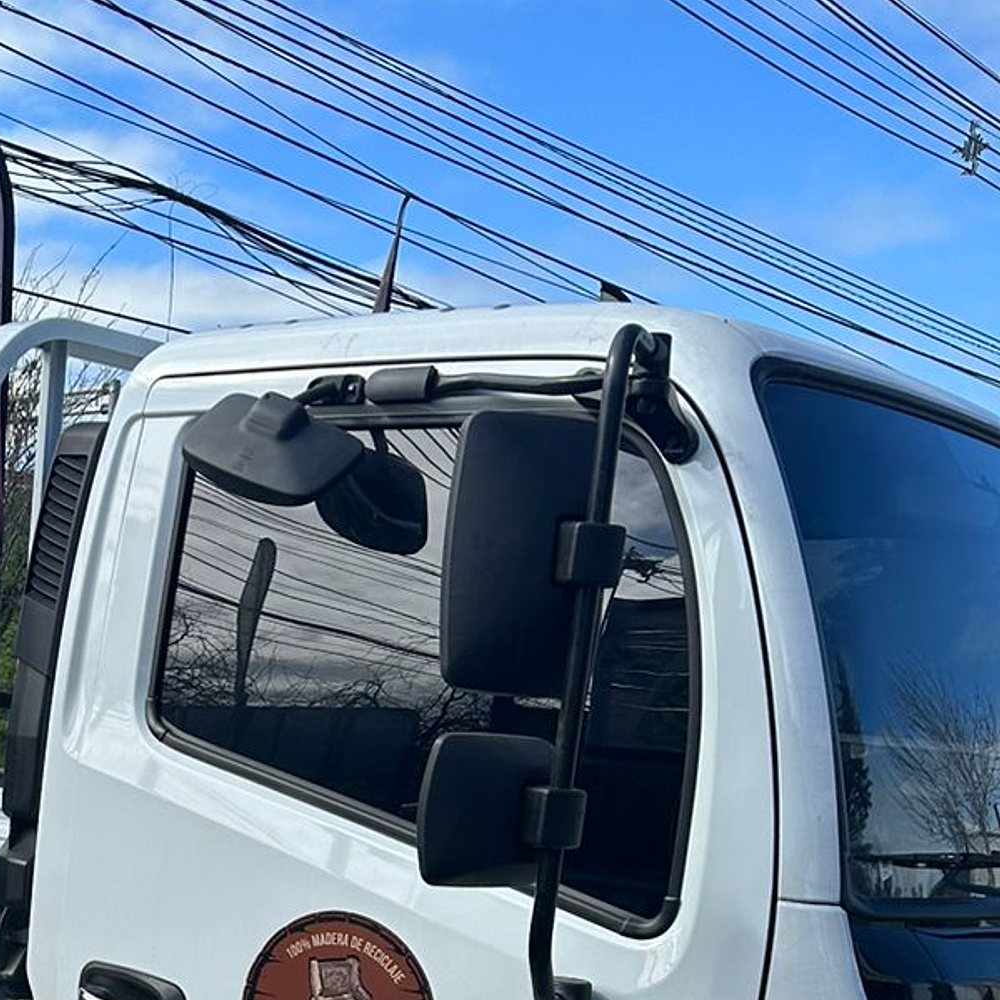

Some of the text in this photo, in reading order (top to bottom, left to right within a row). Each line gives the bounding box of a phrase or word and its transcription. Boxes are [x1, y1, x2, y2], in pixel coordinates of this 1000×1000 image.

[286, 932, 407, 985] 100% MADERA DE RECICLAJE
